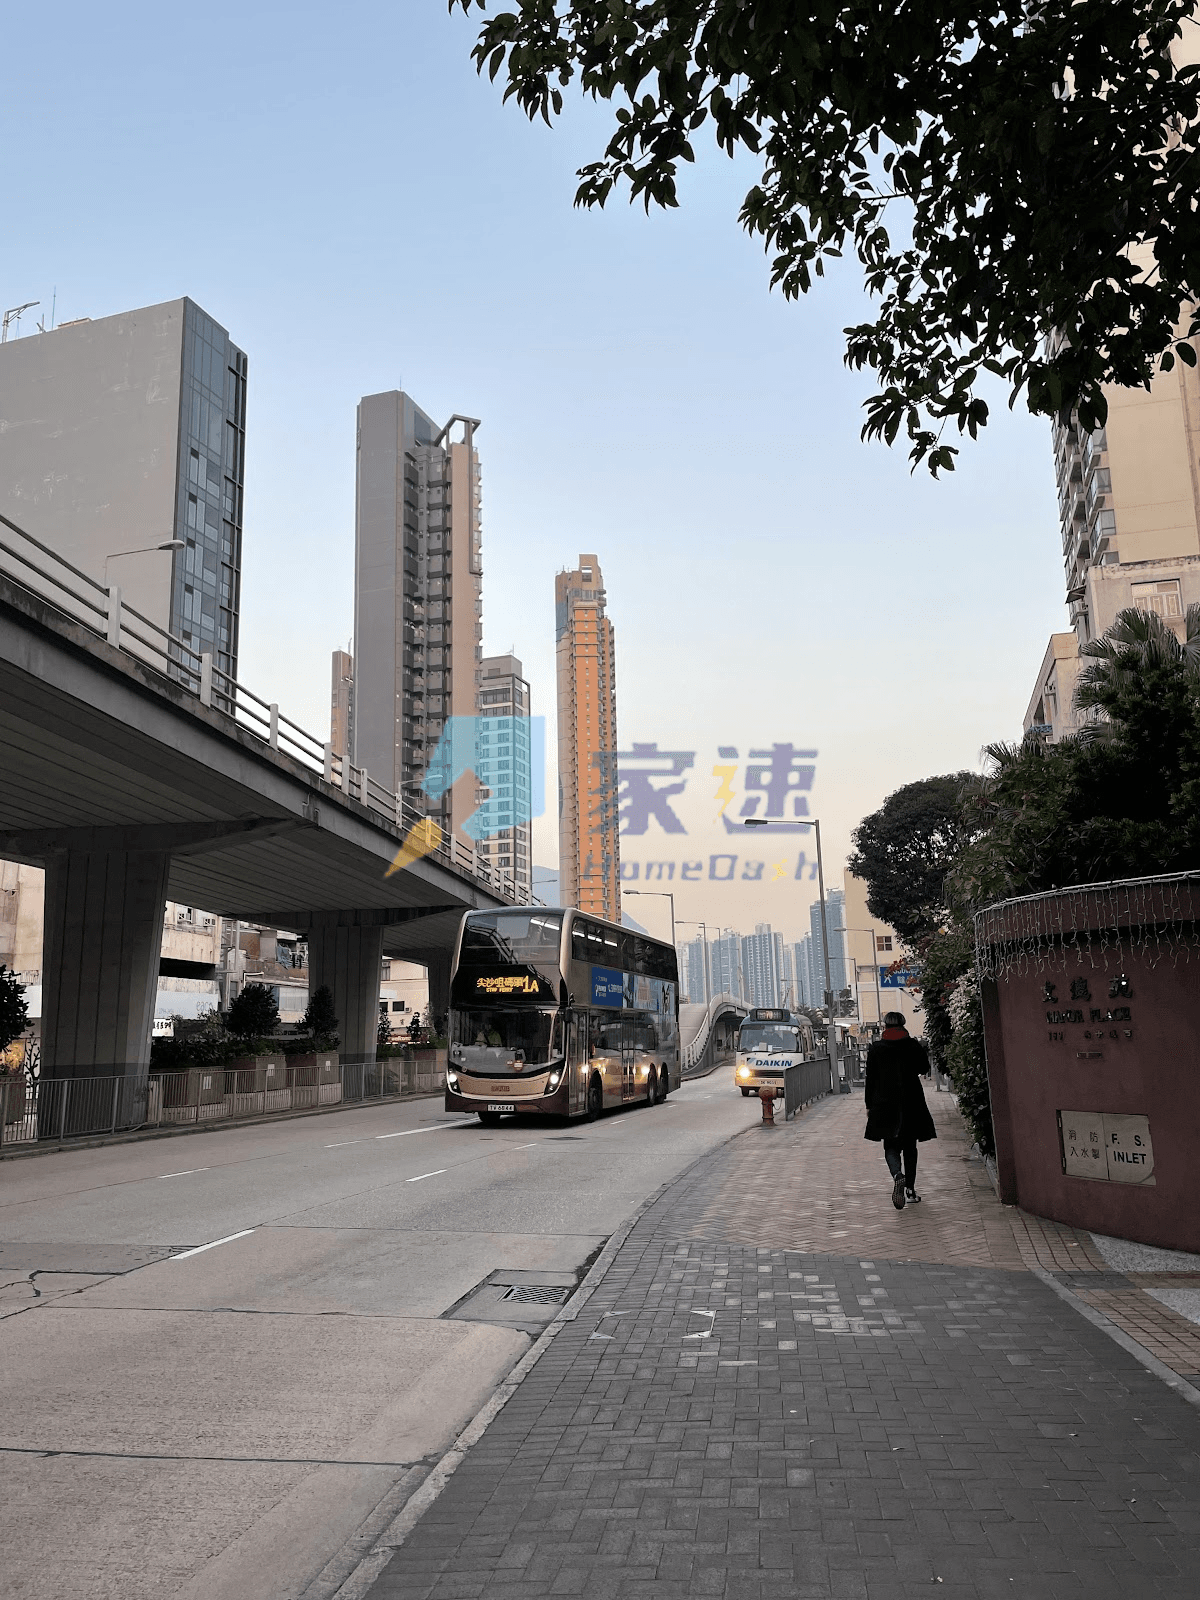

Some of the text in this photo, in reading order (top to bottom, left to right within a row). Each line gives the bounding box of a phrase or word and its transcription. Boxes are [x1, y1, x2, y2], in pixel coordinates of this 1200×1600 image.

[523, 975, 539, 993] 1A
[1090, 1006, 1131, 1022] PLACE
[1068, 1129, 1099, 1143] 消防
[1111, 1133, 1146, 1147] F. S.
[1113, 1150, 1147, 1165] INLET
